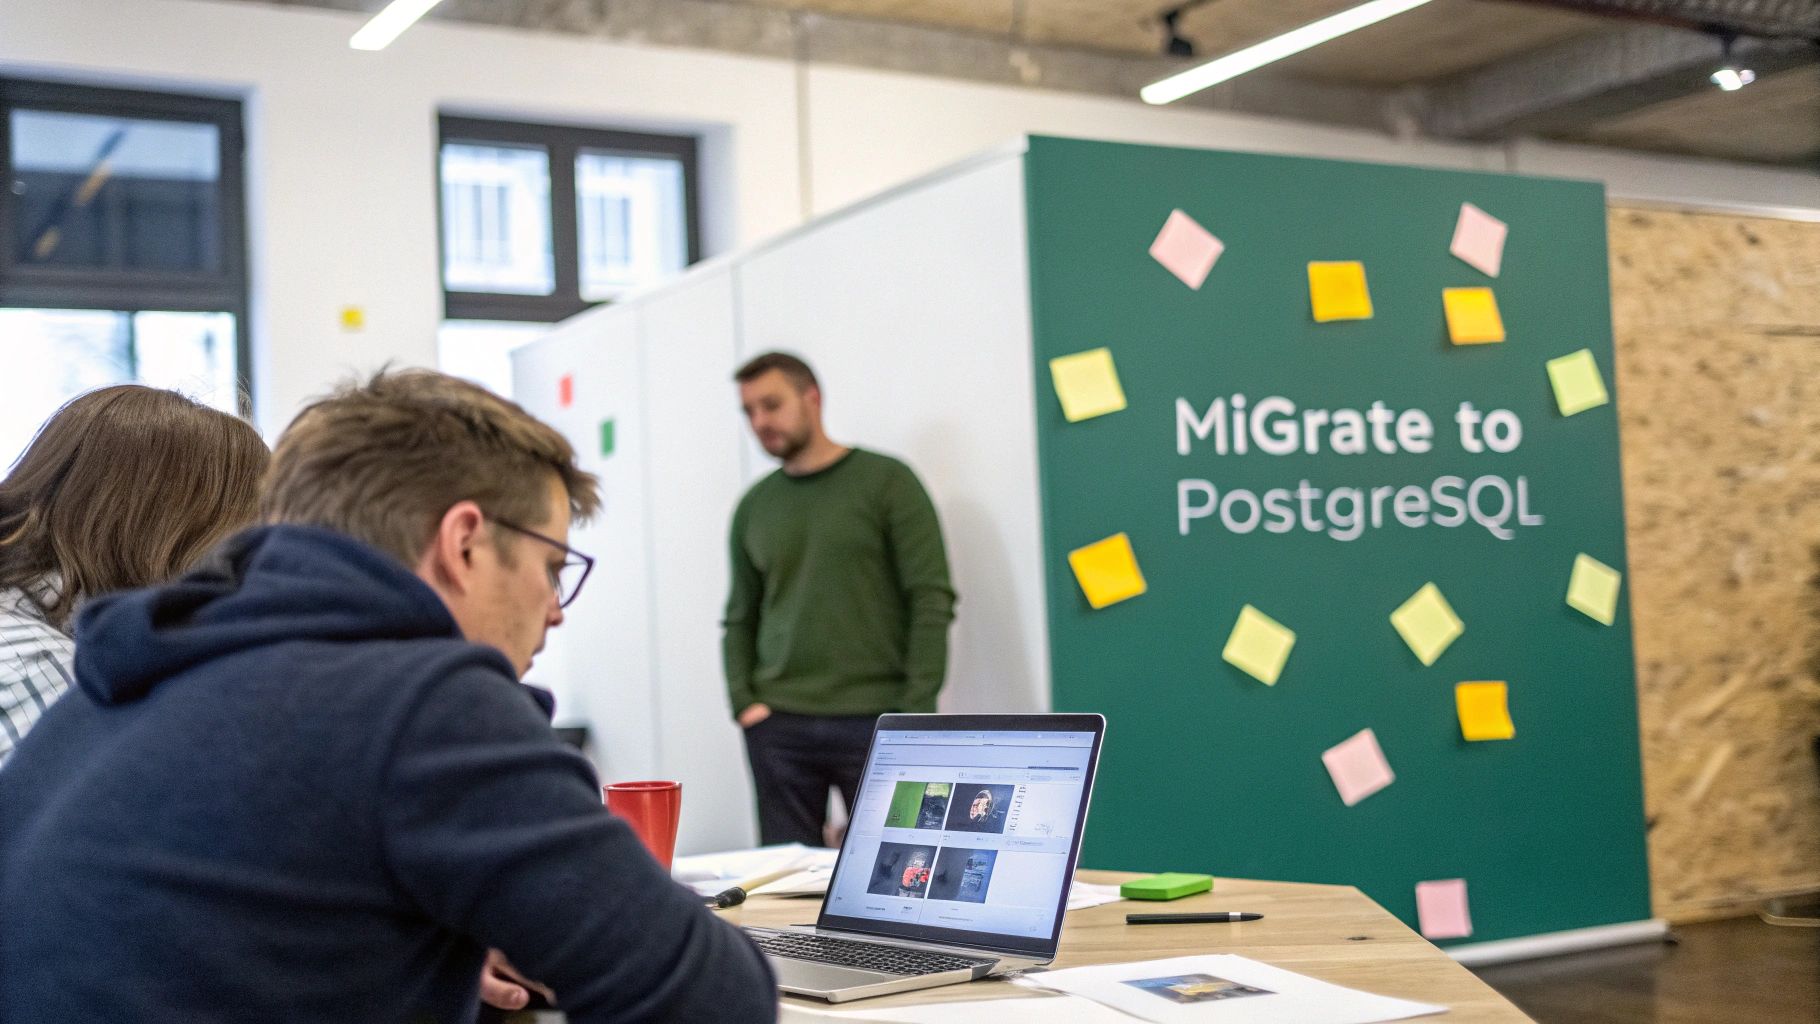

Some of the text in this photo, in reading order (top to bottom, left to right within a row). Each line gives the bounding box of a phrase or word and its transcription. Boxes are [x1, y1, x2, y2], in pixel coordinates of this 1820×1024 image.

[1175, 393, 1523, 456] MiGrate to
[1176, 474, 1544, 542] PostgreSQL
